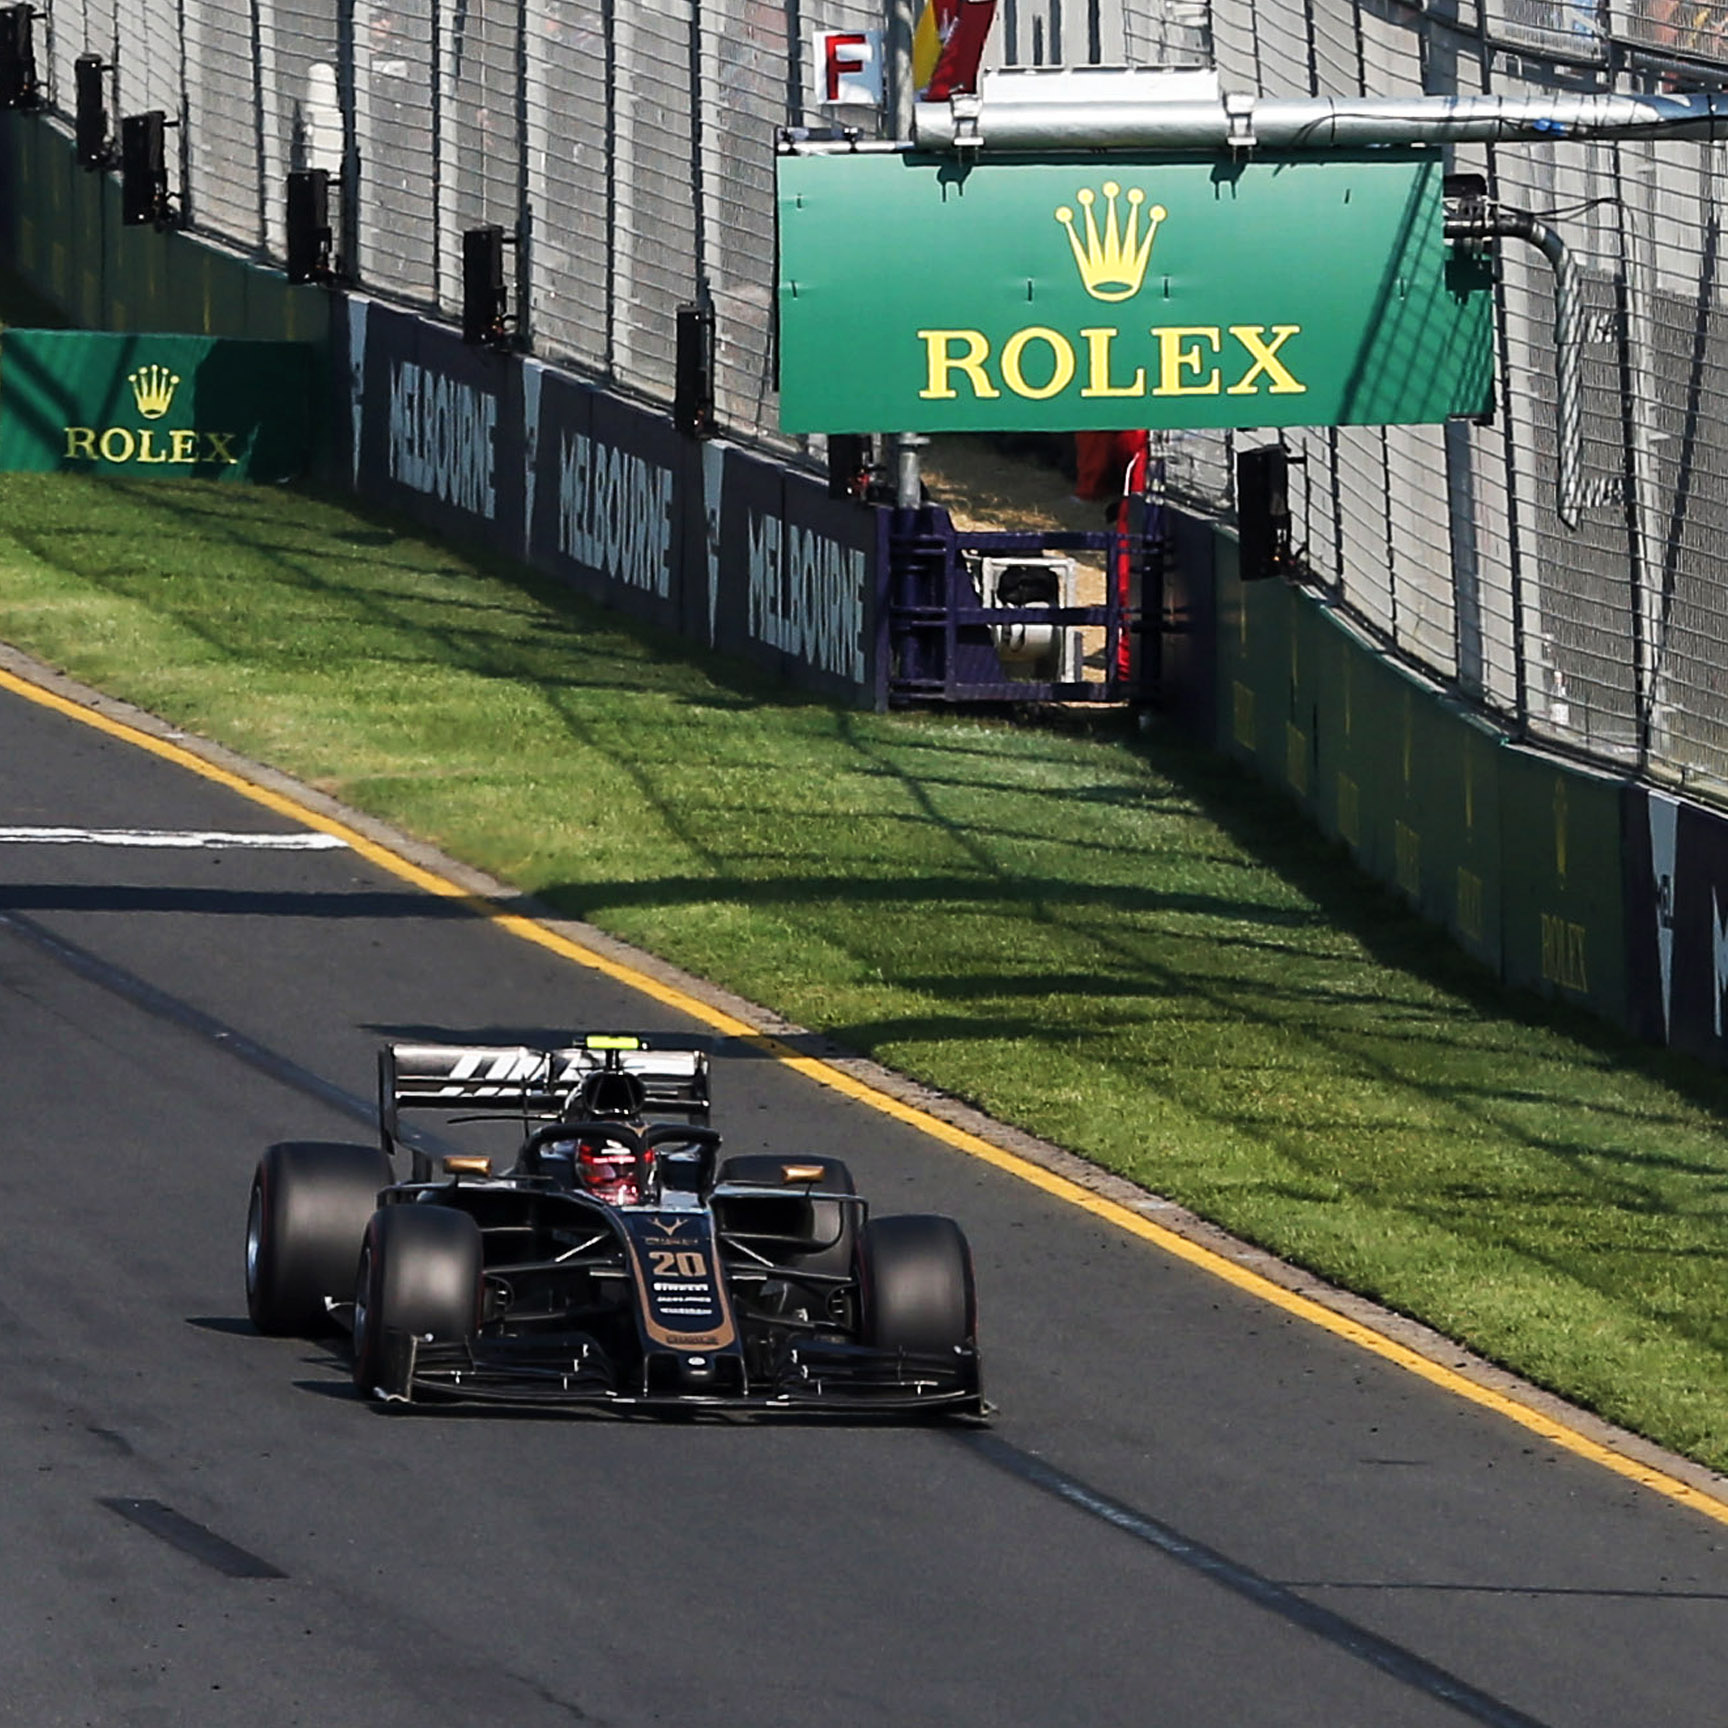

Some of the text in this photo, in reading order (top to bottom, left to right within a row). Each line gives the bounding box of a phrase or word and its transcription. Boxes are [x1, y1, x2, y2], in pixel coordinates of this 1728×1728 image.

[824, 33, 867, 102] F
[918, 325, 1307, 401] ROLEX
[62, 426, 238, 465] ROLEX
[388, 359, 498, 521] MELBOURNE
[558, 425, 674, 600] MELBOURNE
[747, 505, 867, 685] MELBOURNE
[648, 1251, 708, 1278] 20
